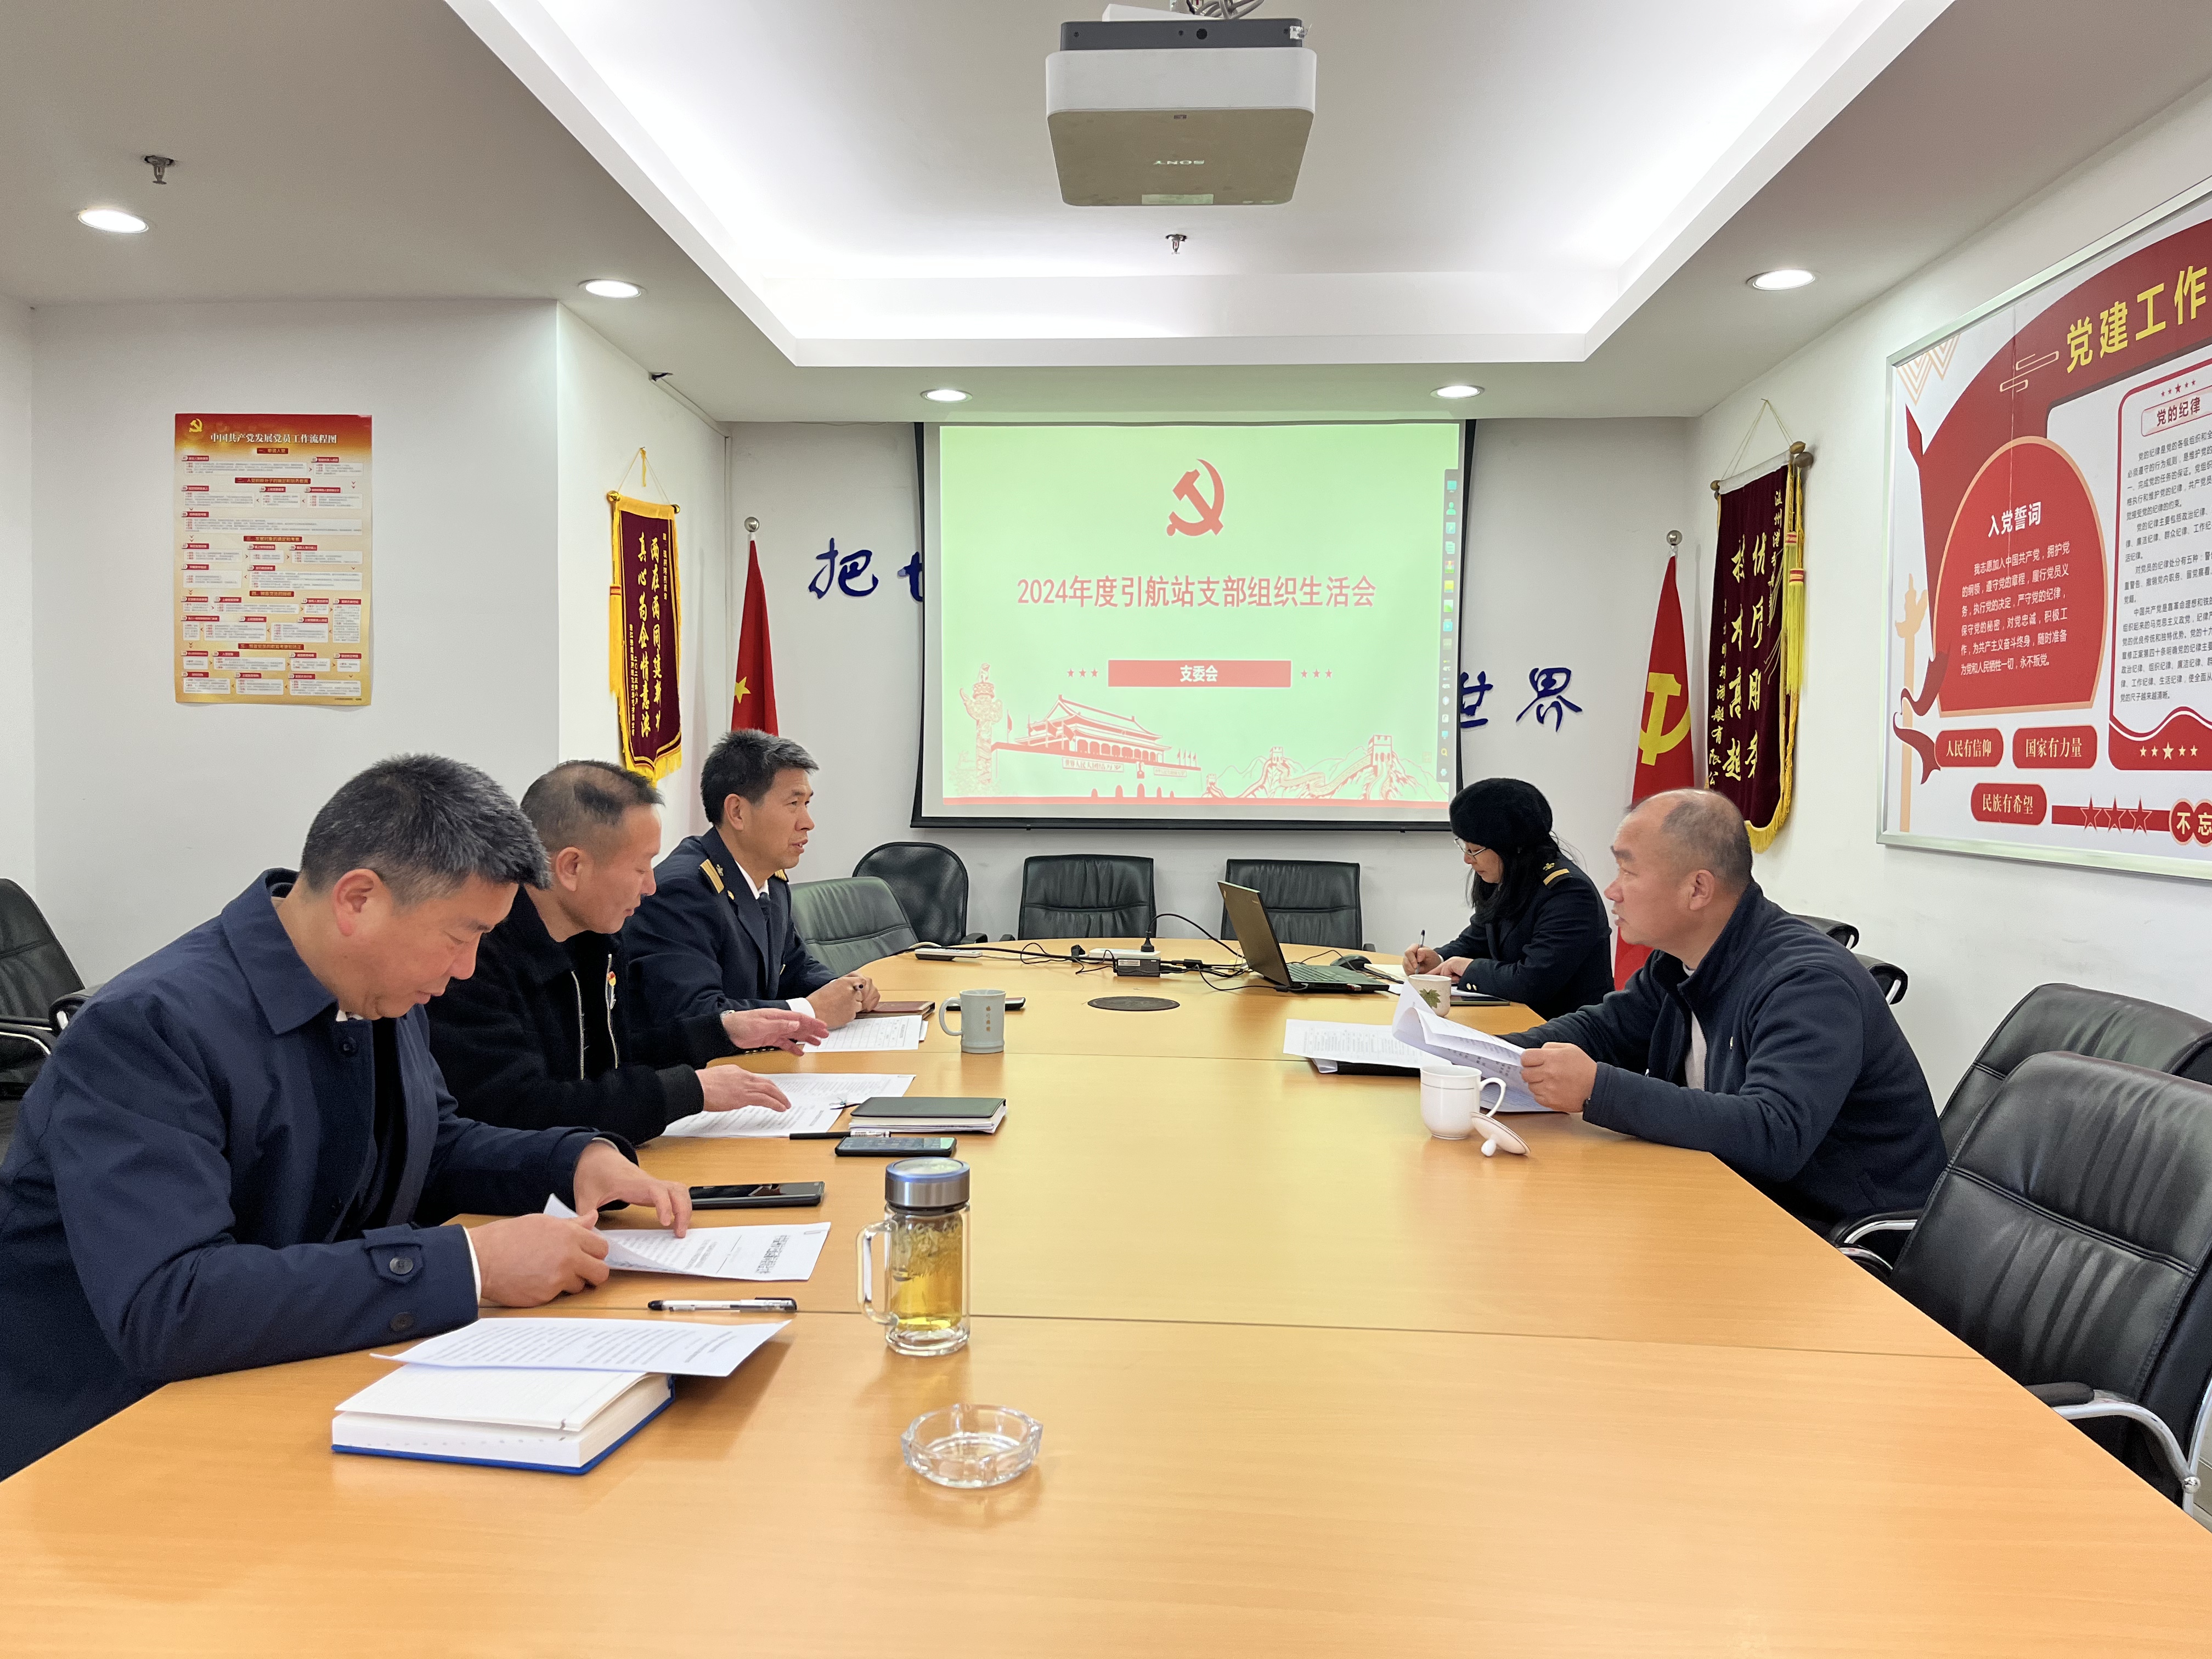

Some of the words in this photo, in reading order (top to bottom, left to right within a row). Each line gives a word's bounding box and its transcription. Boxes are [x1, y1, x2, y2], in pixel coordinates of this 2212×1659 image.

[2067, 266, 2208, 374] 党建工作
[2157, 396, 2200, 427] 党的纪律
[210, 433, 337, 444] 中国共产党发展党员工作流程图
[1988, 501, 2041, 538] 入党誓词
[2125, 521, 2212, 548] 律、廉洁纪律、群众纪律、工作纪
[1974, 540, 2070, 576] 我志愿加入中国共产党，拥护党
[1017, 574, 1376, 608] 2024年度引航站支部组织生活会
[1962, 563, 2069, 597] 的纲领，遵守党的章程，履行党员义
[1961, 586, 2066, 618] 务，执行党的决定，严守党的纪律，
[1961, 607, 2068, 637] 保守党的秘密，对党忠诚，积极工
[1961, 629, 2067, 656] 作，为共产主义奋斗终身，随时准备
[1179, 664, 1218, 682] 支委会
[1960, 653, 2050, 675] 为党和人民牺牲一切，永不叛党。
[1460, 667, 1583, 733] 世界
[1946, 738, 1991, 758] 人民有信仰
[2025, 737, 2082, 758] 国家有力量
[1982, 793, 2033, 815] 民族有希望
[2176, 812, 2212, 836] 不忘
